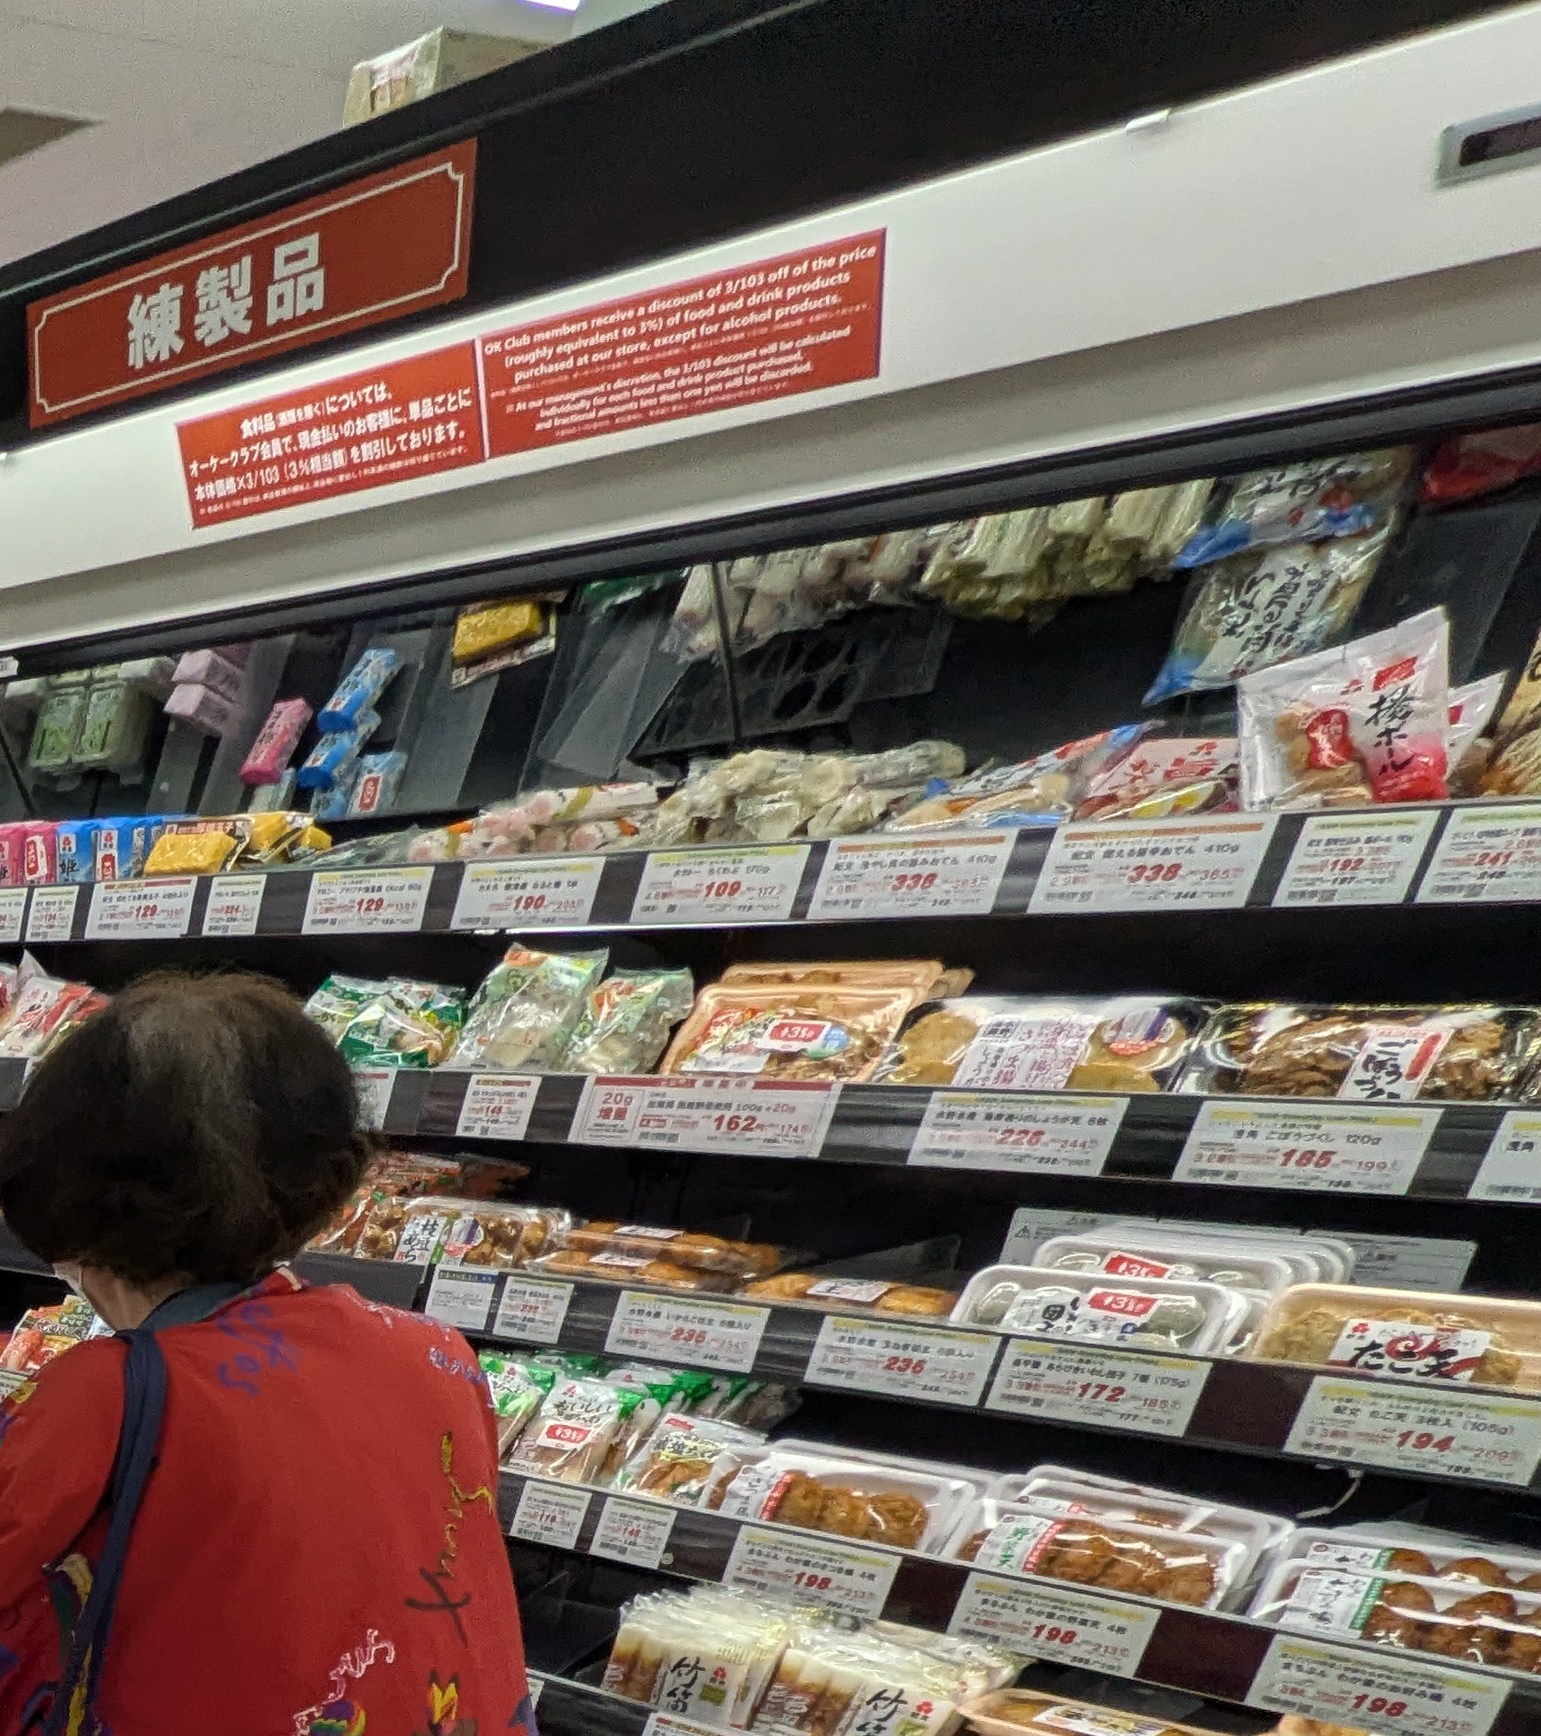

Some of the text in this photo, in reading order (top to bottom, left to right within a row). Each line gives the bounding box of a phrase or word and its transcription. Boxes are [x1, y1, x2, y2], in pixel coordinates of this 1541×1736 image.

[126, 233, 325, 371] 練製品
[504, 333, 531, 350] Club
[533, 321, 588, 344] members
[591, 306, 634, 331] receive
[648, 289, 700, 315] discount
[706, 282, 722, 298] of
[725, 273, 764, 293] 3/103
[815, 255, 836, 272] the
[838, 245, 877, 267] price
[505, 345, 554, 369] (roughly
[556, 328, 619, 357] equivalent
[623, 326, 636, 339] to
[667, 312, 682, 329] of
[684, 305, 715, 323] food
[718, 297, 744, 314] and
[746, 289, 783, 309] drink
[785, 271, 851, 304] products
[514, 294, 841, 384] purchased at our store, except for alcohol products.
[1129, 862, 1182, 882] 338
[600, 1091, 634, 1107] 20g
[714, 1114, 757, 1132] 162
[1282, 1149, 1335, 1168] 185
[1079, 1382, 1125, 1403] 172
[1398, 1431, 1454, 1453] 194
[795, 1572, 832, 1591] 198
[1033, 1624, 1077, 1645] 198
[1353, 1694, 1407, 1717] 198
